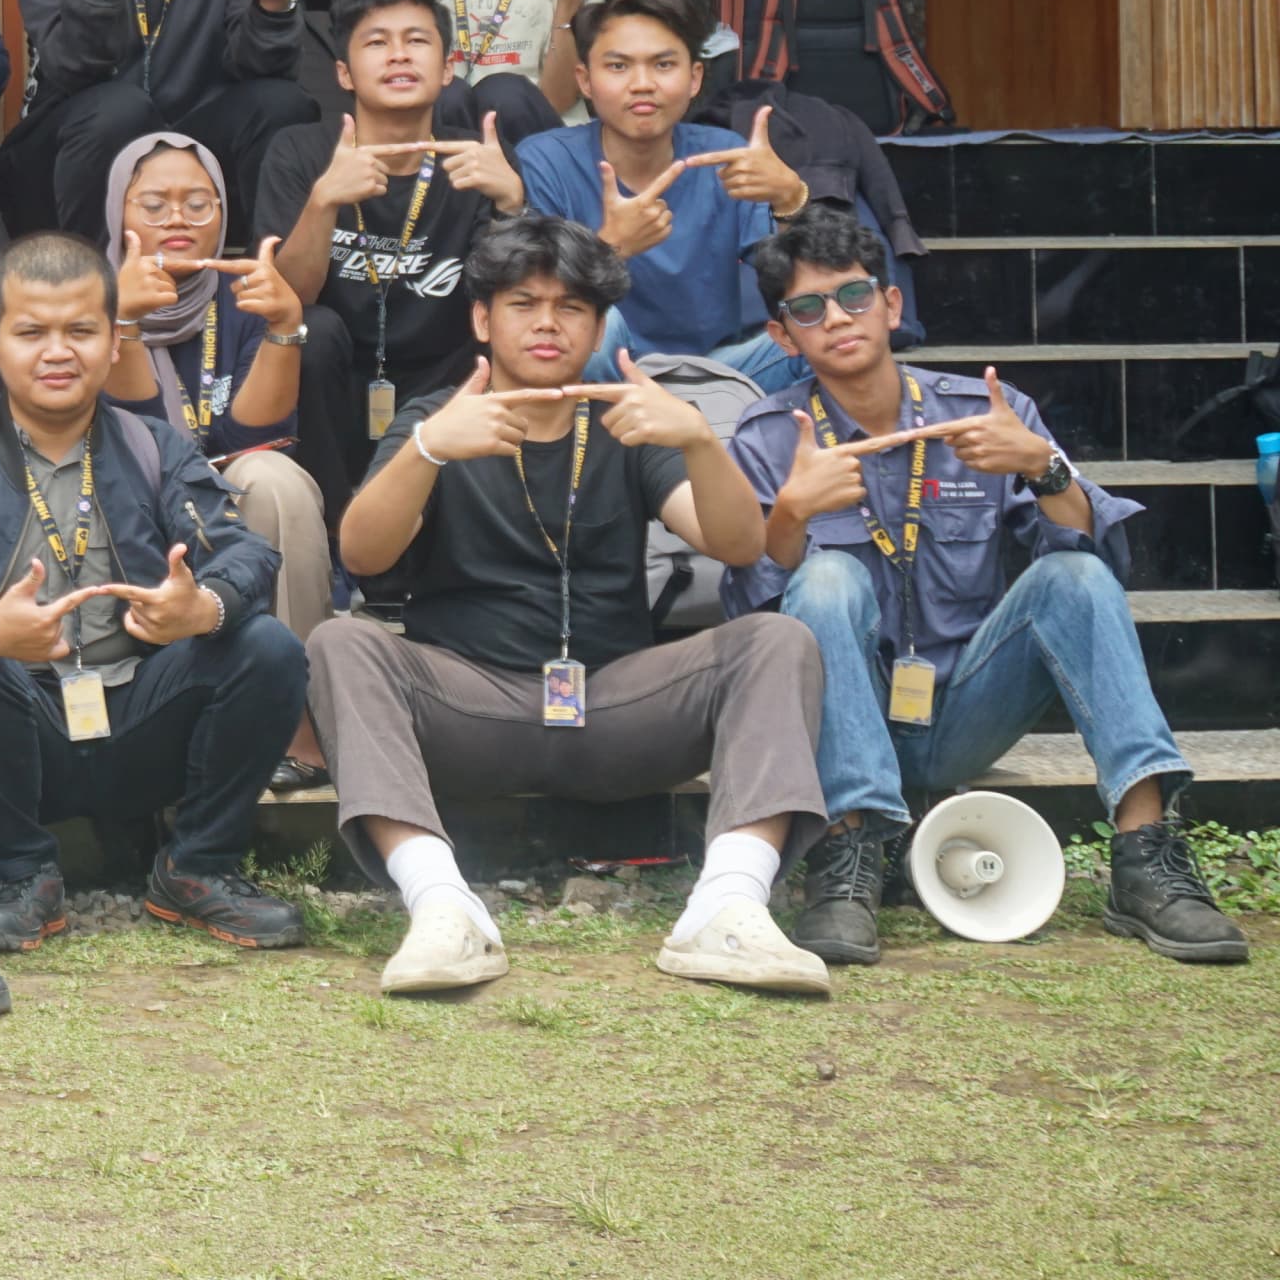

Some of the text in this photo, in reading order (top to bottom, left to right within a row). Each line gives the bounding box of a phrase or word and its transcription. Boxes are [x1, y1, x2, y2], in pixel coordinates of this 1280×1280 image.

[410, 182, 430, 220] UDINUS
[203, 329, 216, 370] UDINUS
[577, 416, 589, 445] HMTI
[907, 440, 926, 509] HMTI UDINU
